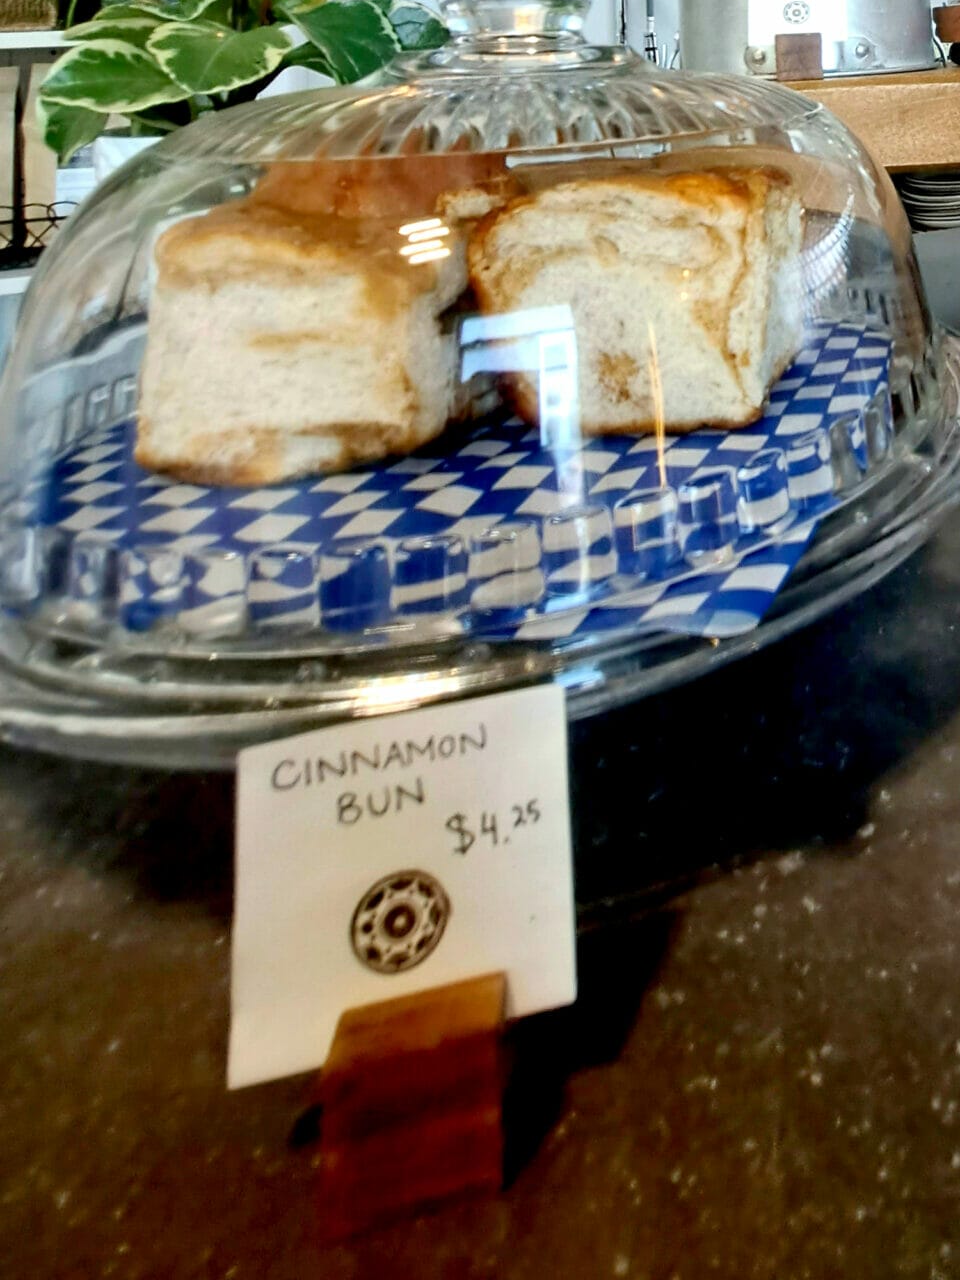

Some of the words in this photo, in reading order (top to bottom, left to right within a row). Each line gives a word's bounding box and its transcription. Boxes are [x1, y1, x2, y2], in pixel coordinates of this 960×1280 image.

[270, 722, 489, 791] CINNAMON
[335, 777, 426, 826] BUN
[445, 798, 543, 856] $4.25
